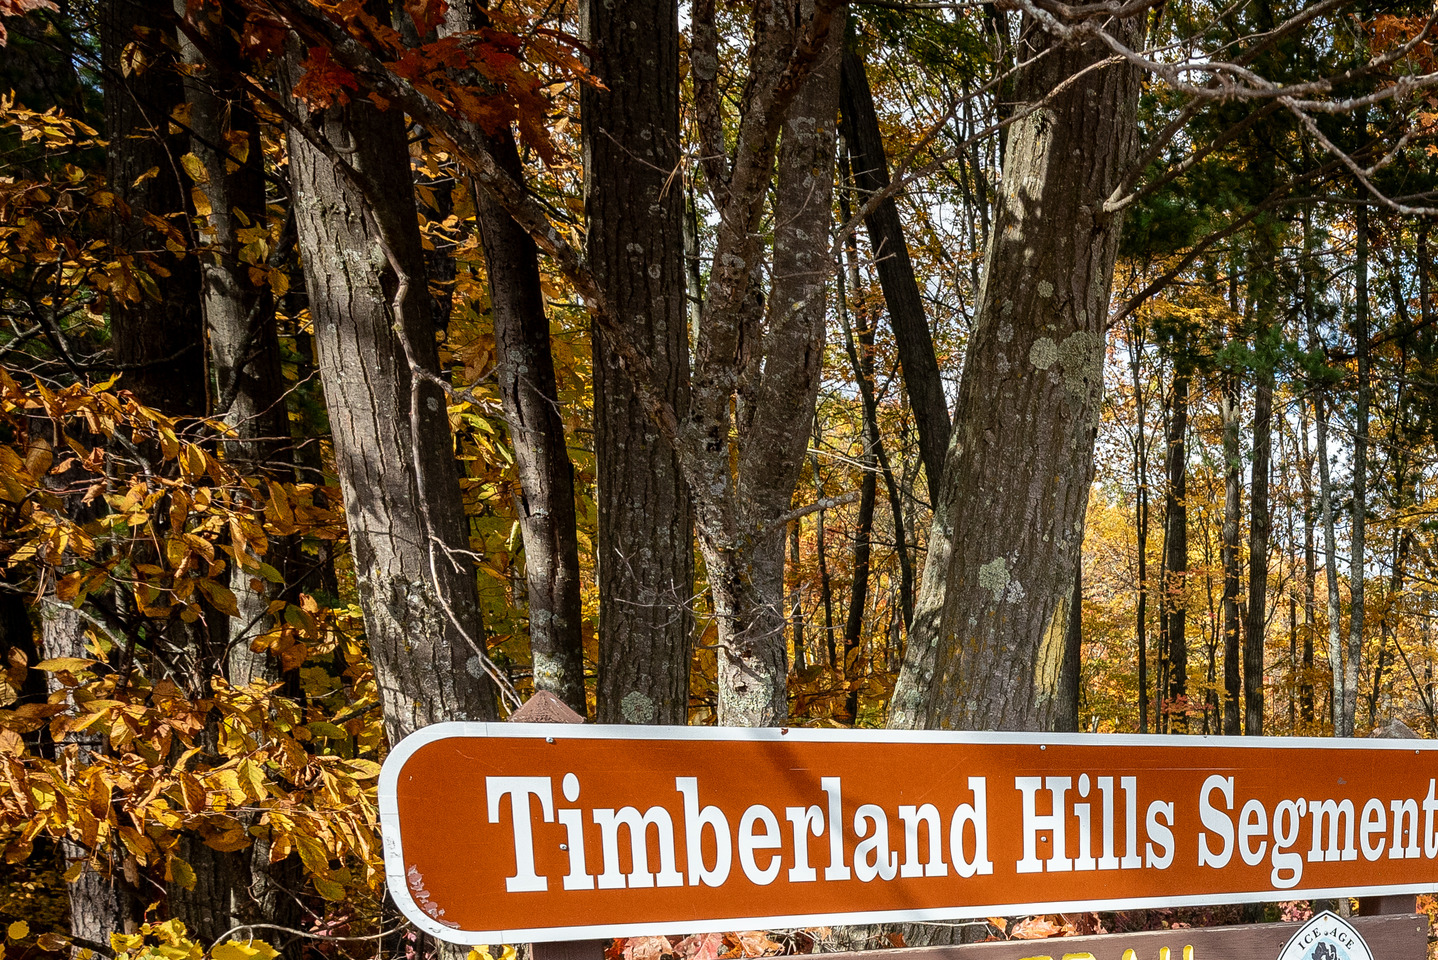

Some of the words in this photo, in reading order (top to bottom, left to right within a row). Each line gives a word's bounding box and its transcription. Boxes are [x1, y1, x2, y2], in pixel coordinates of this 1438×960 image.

[485, 772, 994, 893] Timberland
[1015, 773, 1175, 874] Hills
[1298, 927, 1321, 950] ICE
[1330, 927, 1354, 949] AGE
